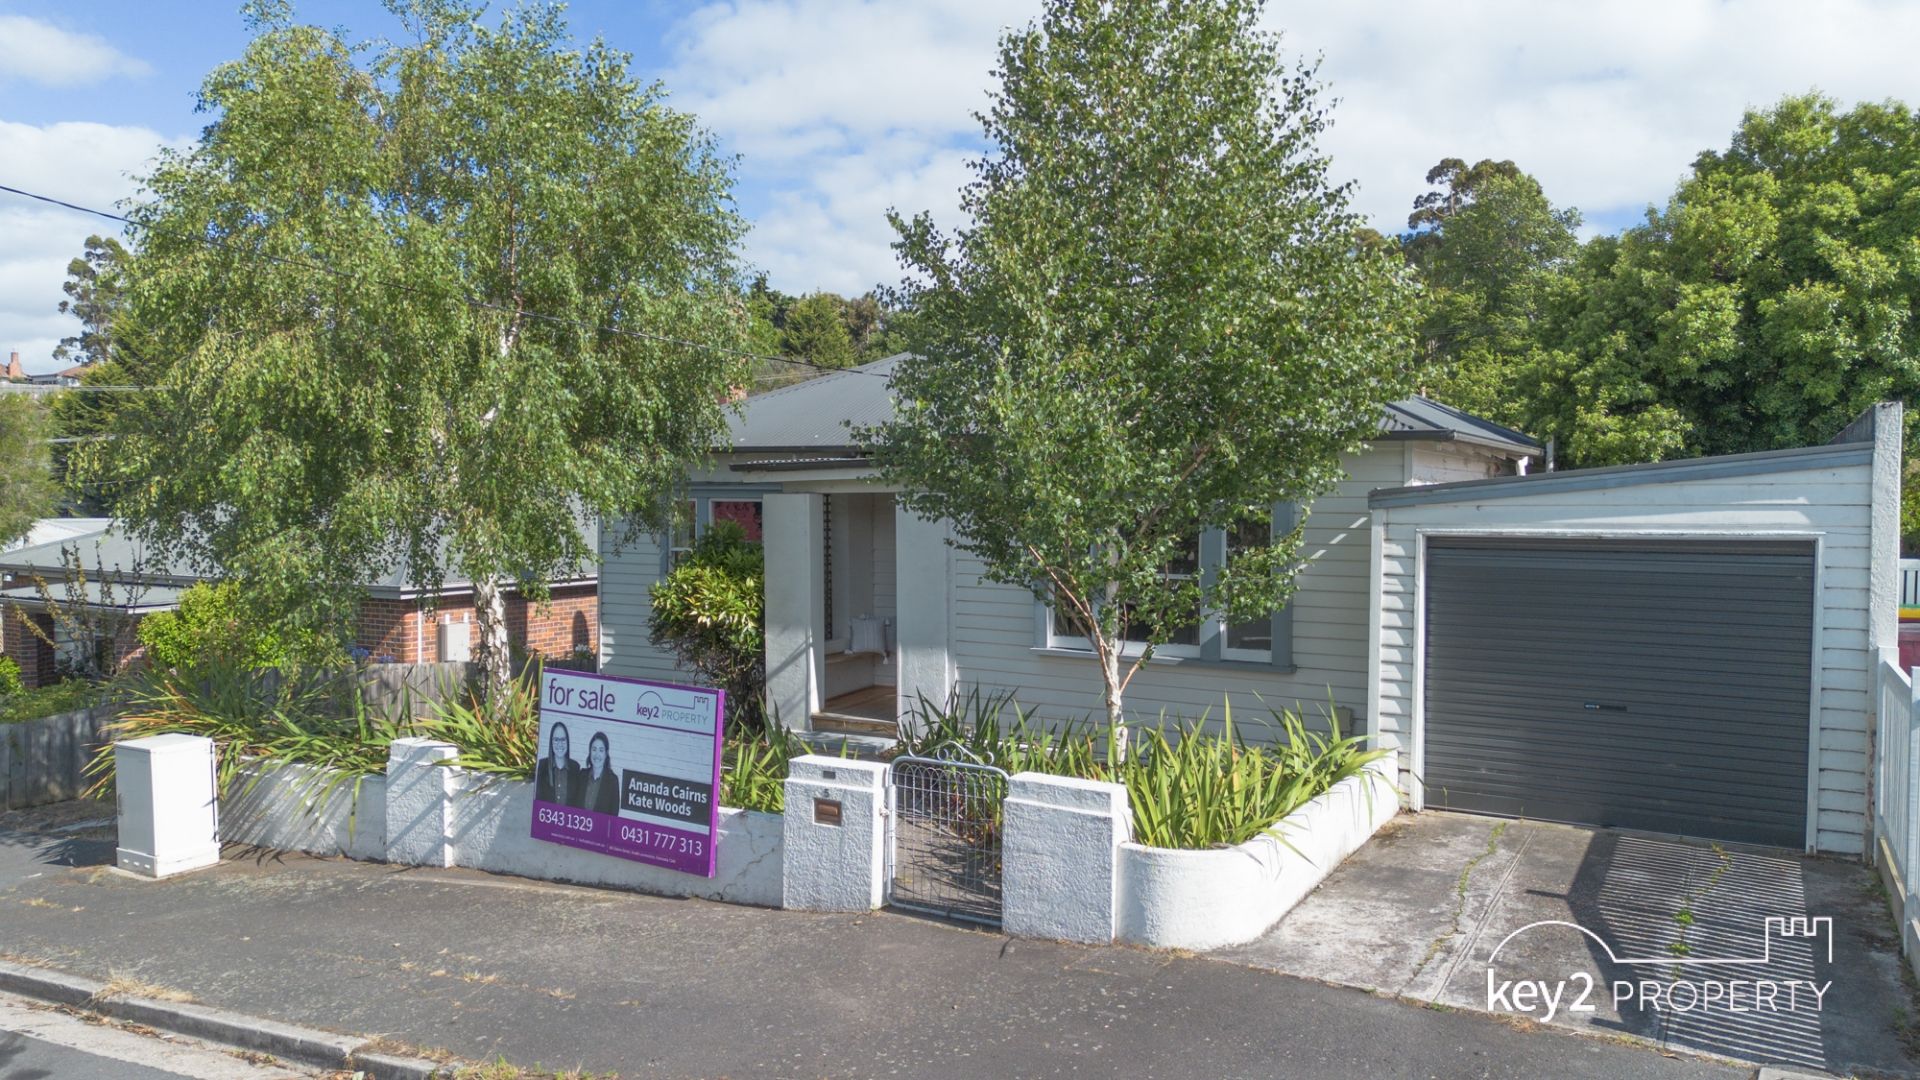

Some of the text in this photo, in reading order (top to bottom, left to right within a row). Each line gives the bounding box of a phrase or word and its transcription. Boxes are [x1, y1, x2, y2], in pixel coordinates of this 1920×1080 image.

[549, 678, 615, 713] for sale
[636, 703, 708, 725] key2 PROPERTY
[628, 778, 708, 804] Ananda Cairns
[628, 793, 692, 816] Kate Woods
[538, 808, 593, 832] 6343 1329
[621, 825, 650, 845] 0431
[654, 832, 677, 850] 777
[679, 837, 703, 856] 313
